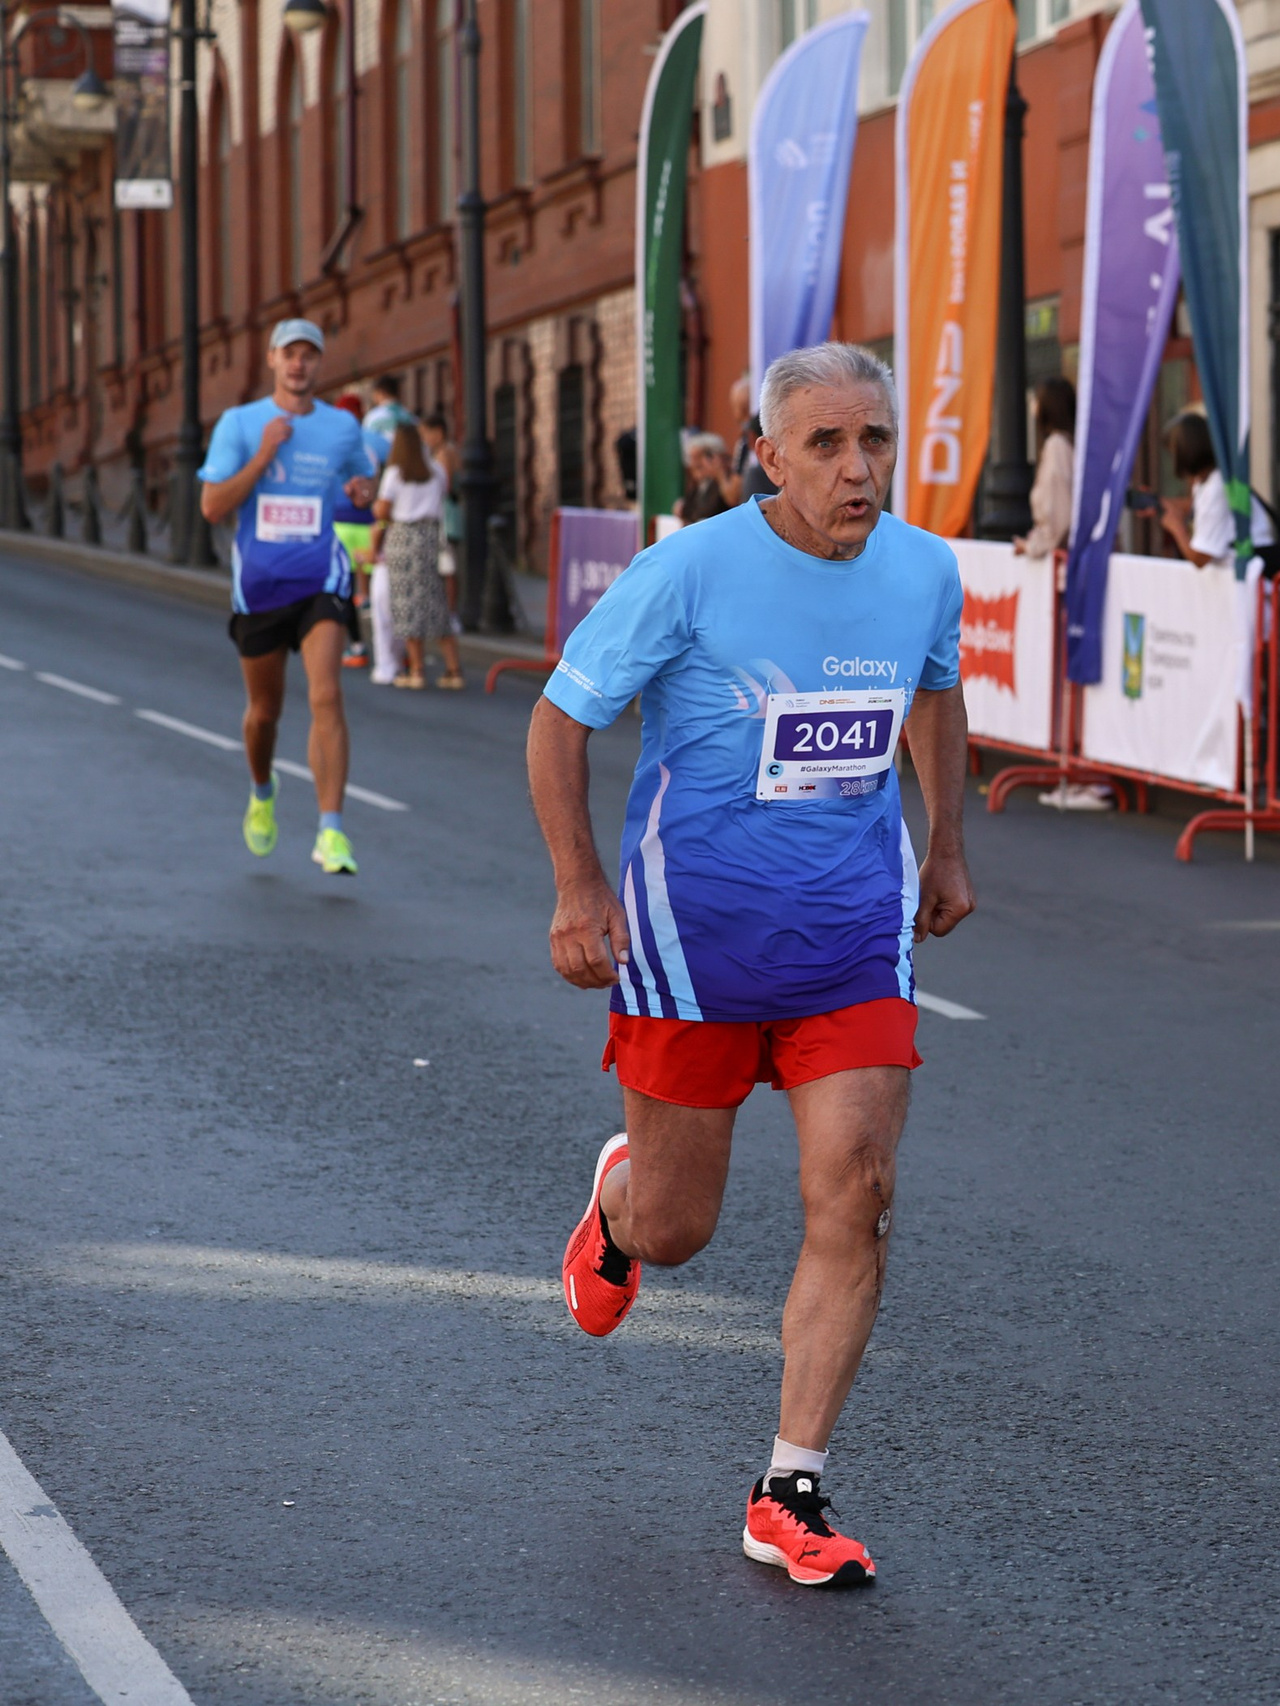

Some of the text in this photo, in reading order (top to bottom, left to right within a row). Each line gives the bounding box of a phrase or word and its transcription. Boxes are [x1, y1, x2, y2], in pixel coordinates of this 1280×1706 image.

[822, 656, 898, 683] Galaxy
[792, 720, 878, 752] 2041
[769, 765, 780, 775] C
[800, 763, 867, 773] #GalaxyMarathon
[840, 779, 878, 796] 28km
